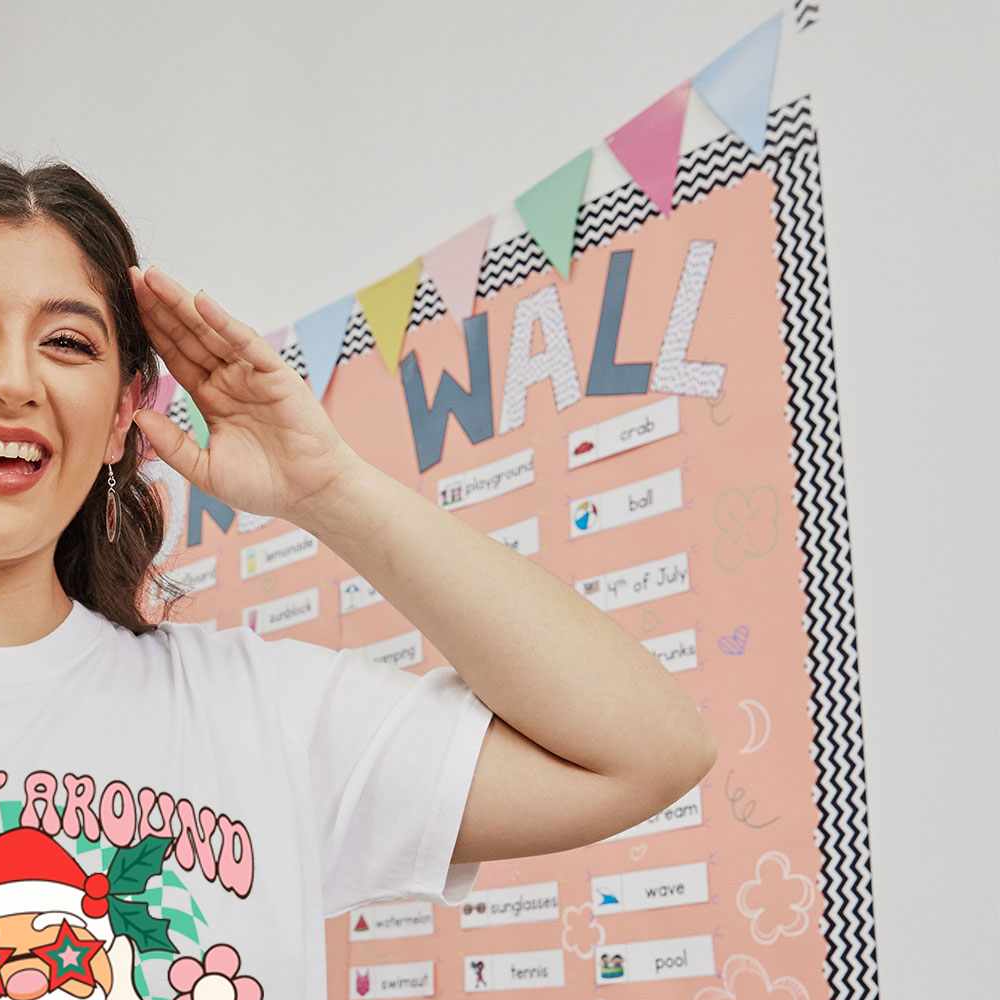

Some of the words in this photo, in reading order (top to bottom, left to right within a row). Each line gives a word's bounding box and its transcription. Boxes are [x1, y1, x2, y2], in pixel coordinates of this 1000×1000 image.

[400, 240, 727, 473] WALL
[619, 417, 655, 441] crab
[465, 455, 535, 497] playground
[628, 489, 654, 513] ball
[633, 571, 650, 593] of
[656, 567, 688, 587] July
[19, 770, 255, 899] AROUND
[644, 883, 685, 899] wave
[490, 894, 560, 918] sunglasses
[510, 962, 549, 981] tennis
[655, 947, 688, 975] pool
